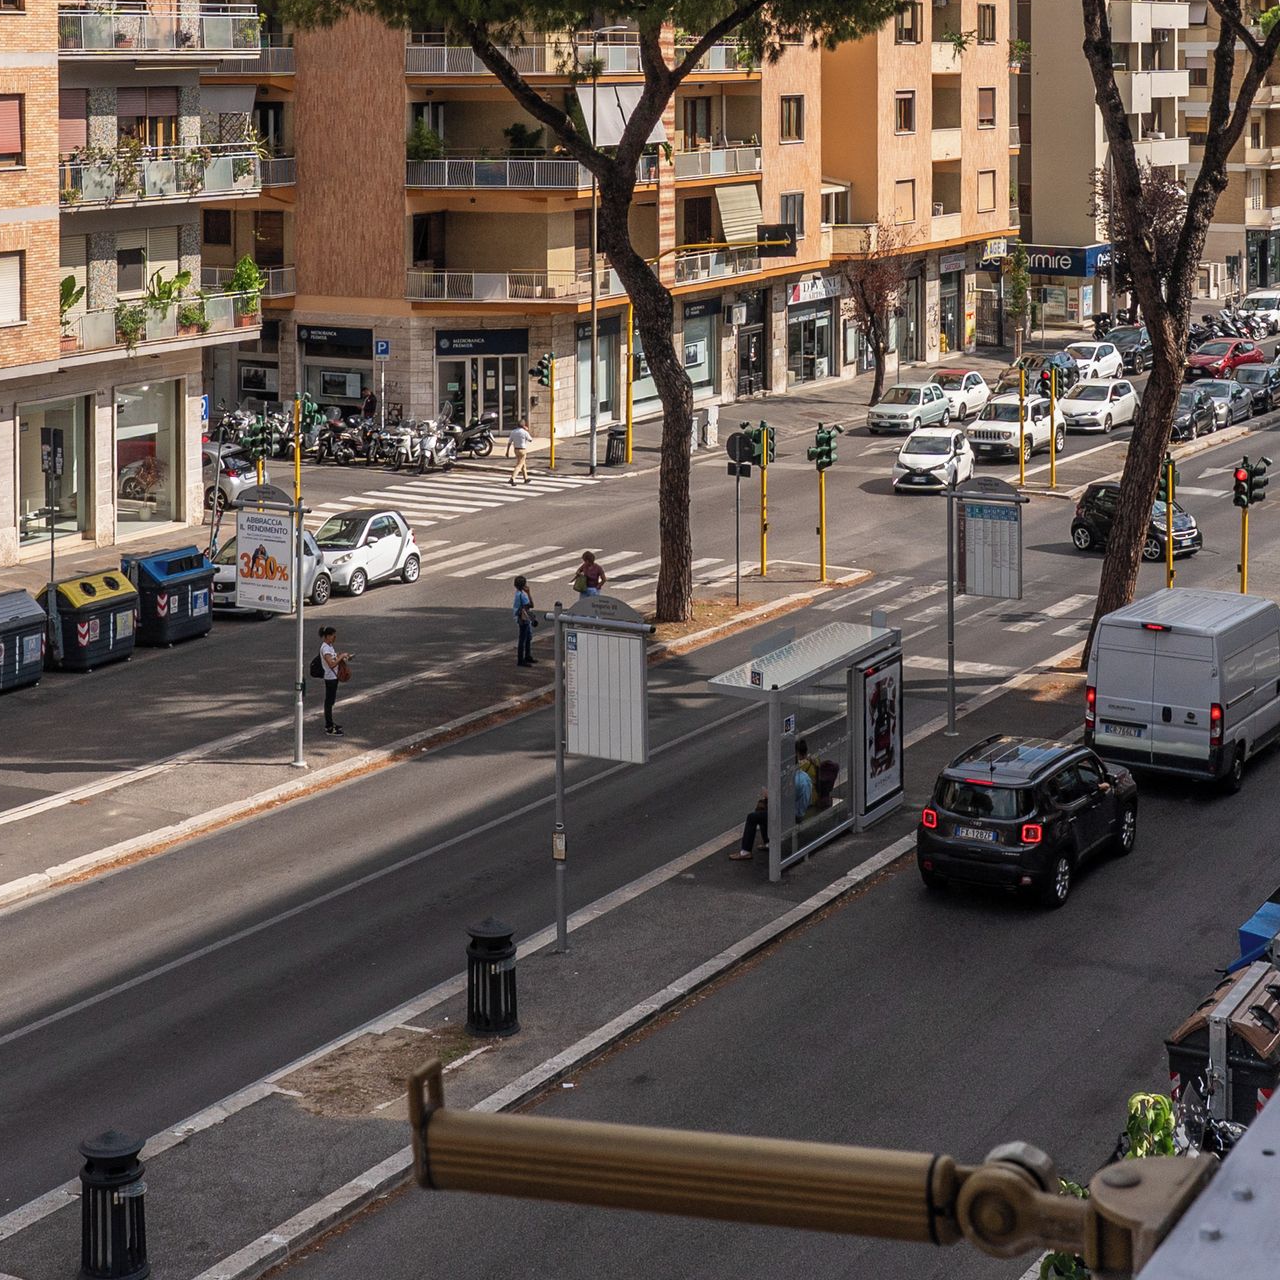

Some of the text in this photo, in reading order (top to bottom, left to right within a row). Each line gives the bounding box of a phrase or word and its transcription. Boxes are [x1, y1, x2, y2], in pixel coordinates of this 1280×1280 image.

[377, 341, 387, 353] P
[246, 516, 283, 526] ABBRACCIA
[247, 524, 288, 535] RENDIMENTO
